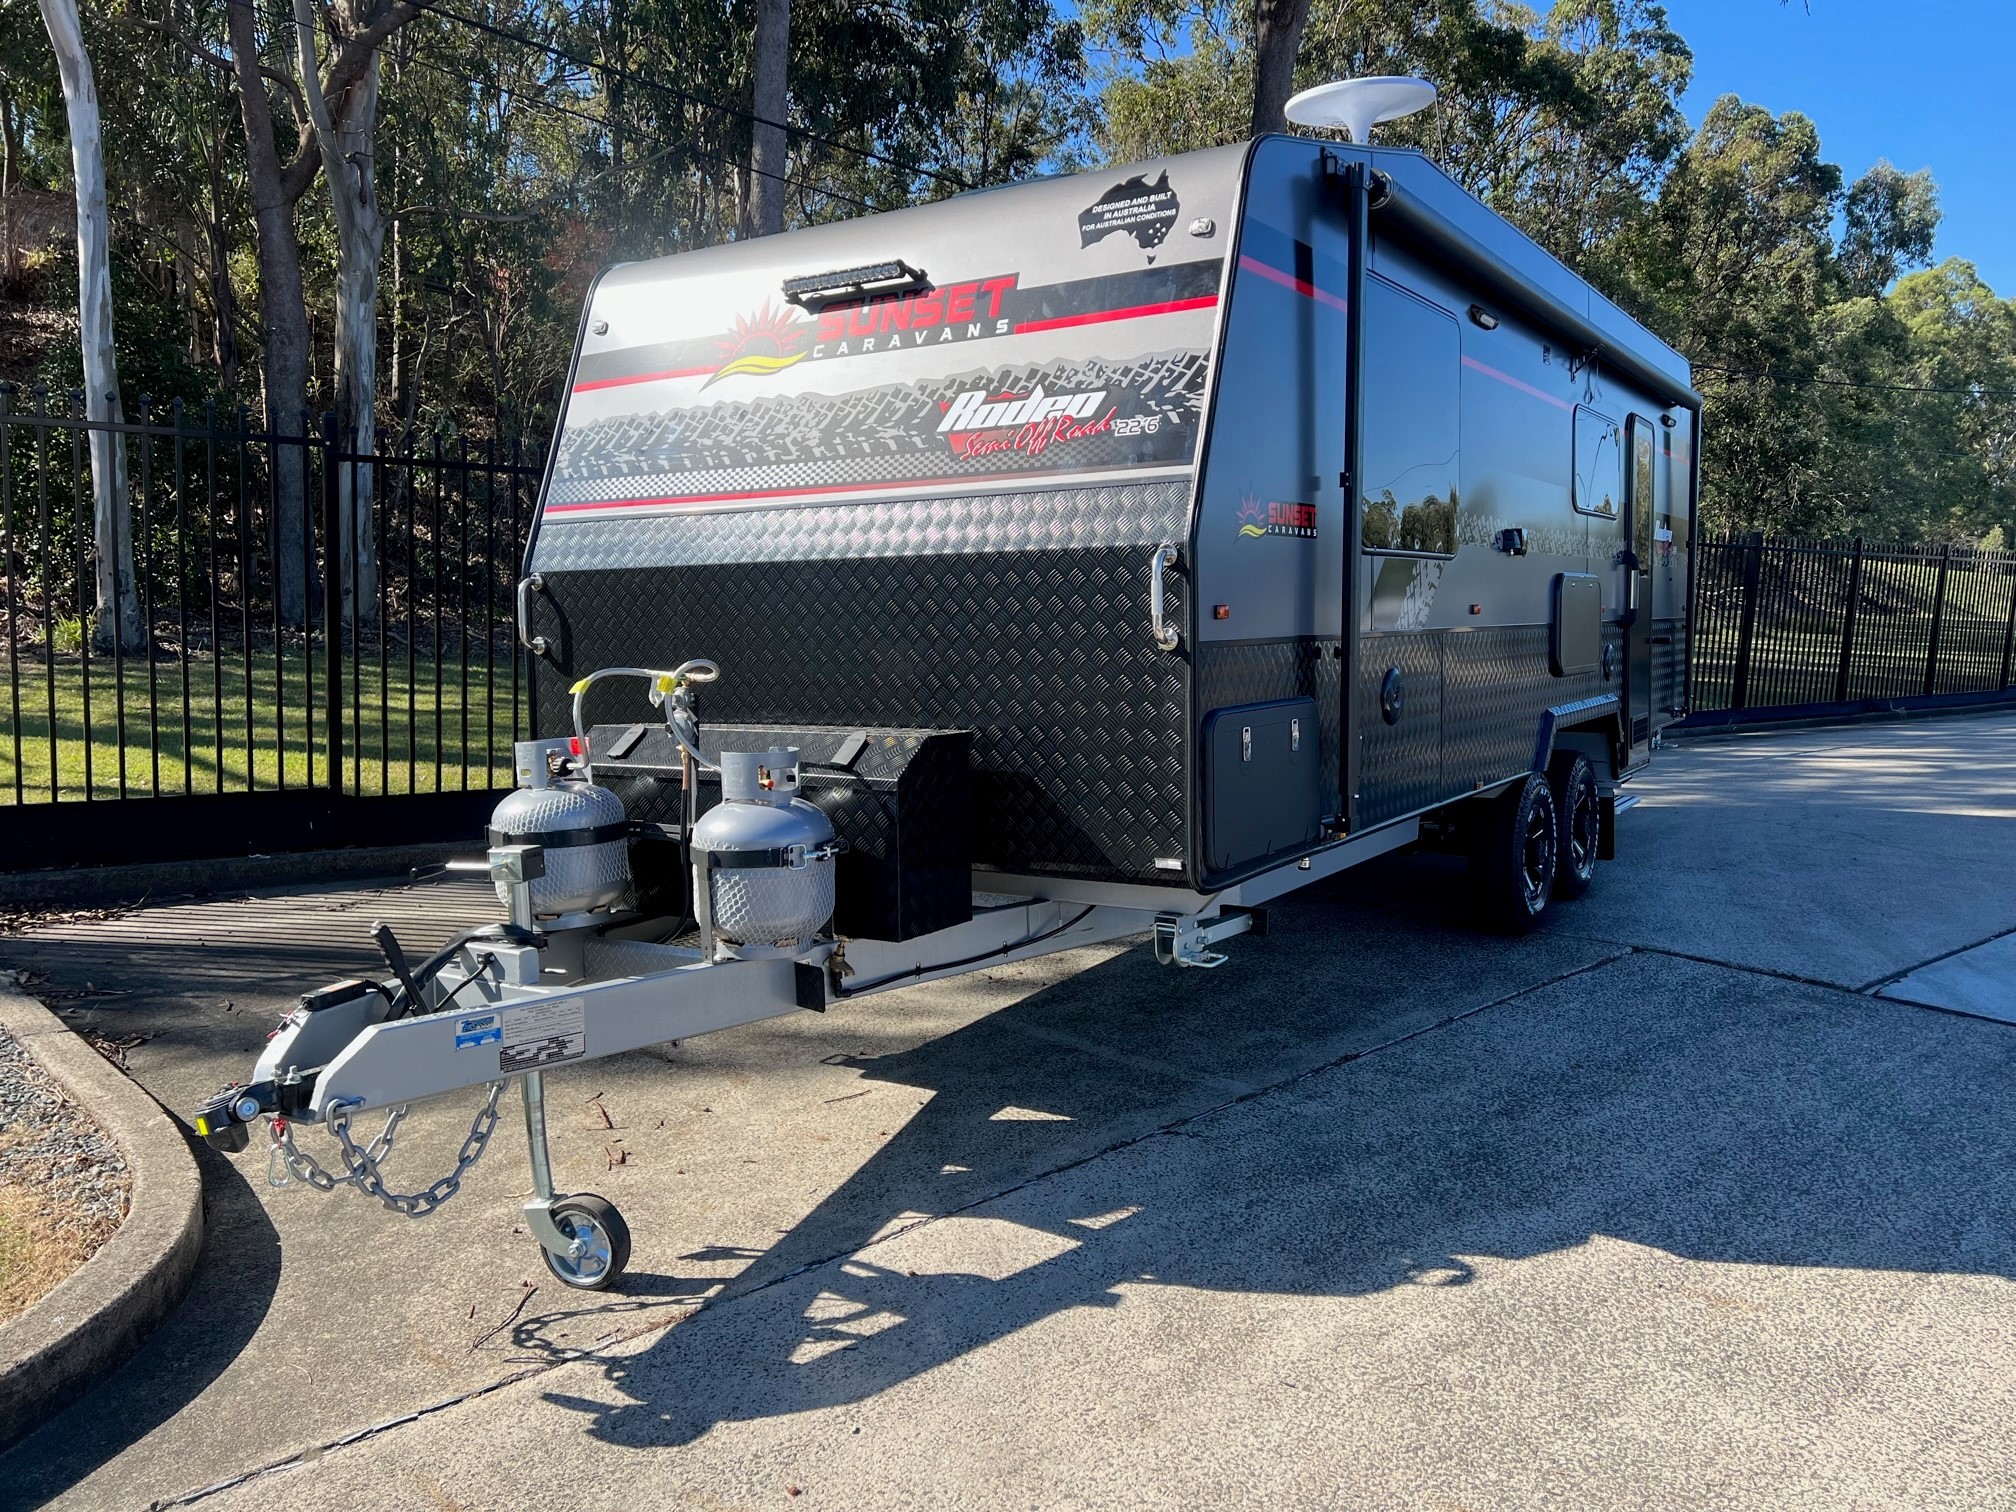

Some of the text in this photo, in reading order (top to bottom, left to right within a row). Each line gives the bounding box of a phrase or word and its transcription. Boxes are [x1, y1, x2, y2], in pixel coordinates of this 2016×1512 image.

[1092, 191, 1173, 213] DESIGNED AND BUILT
[1104, 203, 1156, 220] IN AUSTRALIA
[1082, 208, 1177, 231] FOR AUSTRALIAN CONDITIONS
[815, 276, 1017, 341] SUNSET
[812, 318, 1009, 359] CARAVANS
[936, 384, 1108, 432] Rodeo
[960, 430, 1015, 461] Semi
[1052, 406, 1118, 444] Road
[1268, 502, 1317, 527] SUNSET
[1268, 524, 1317, 537] CARAVANS
